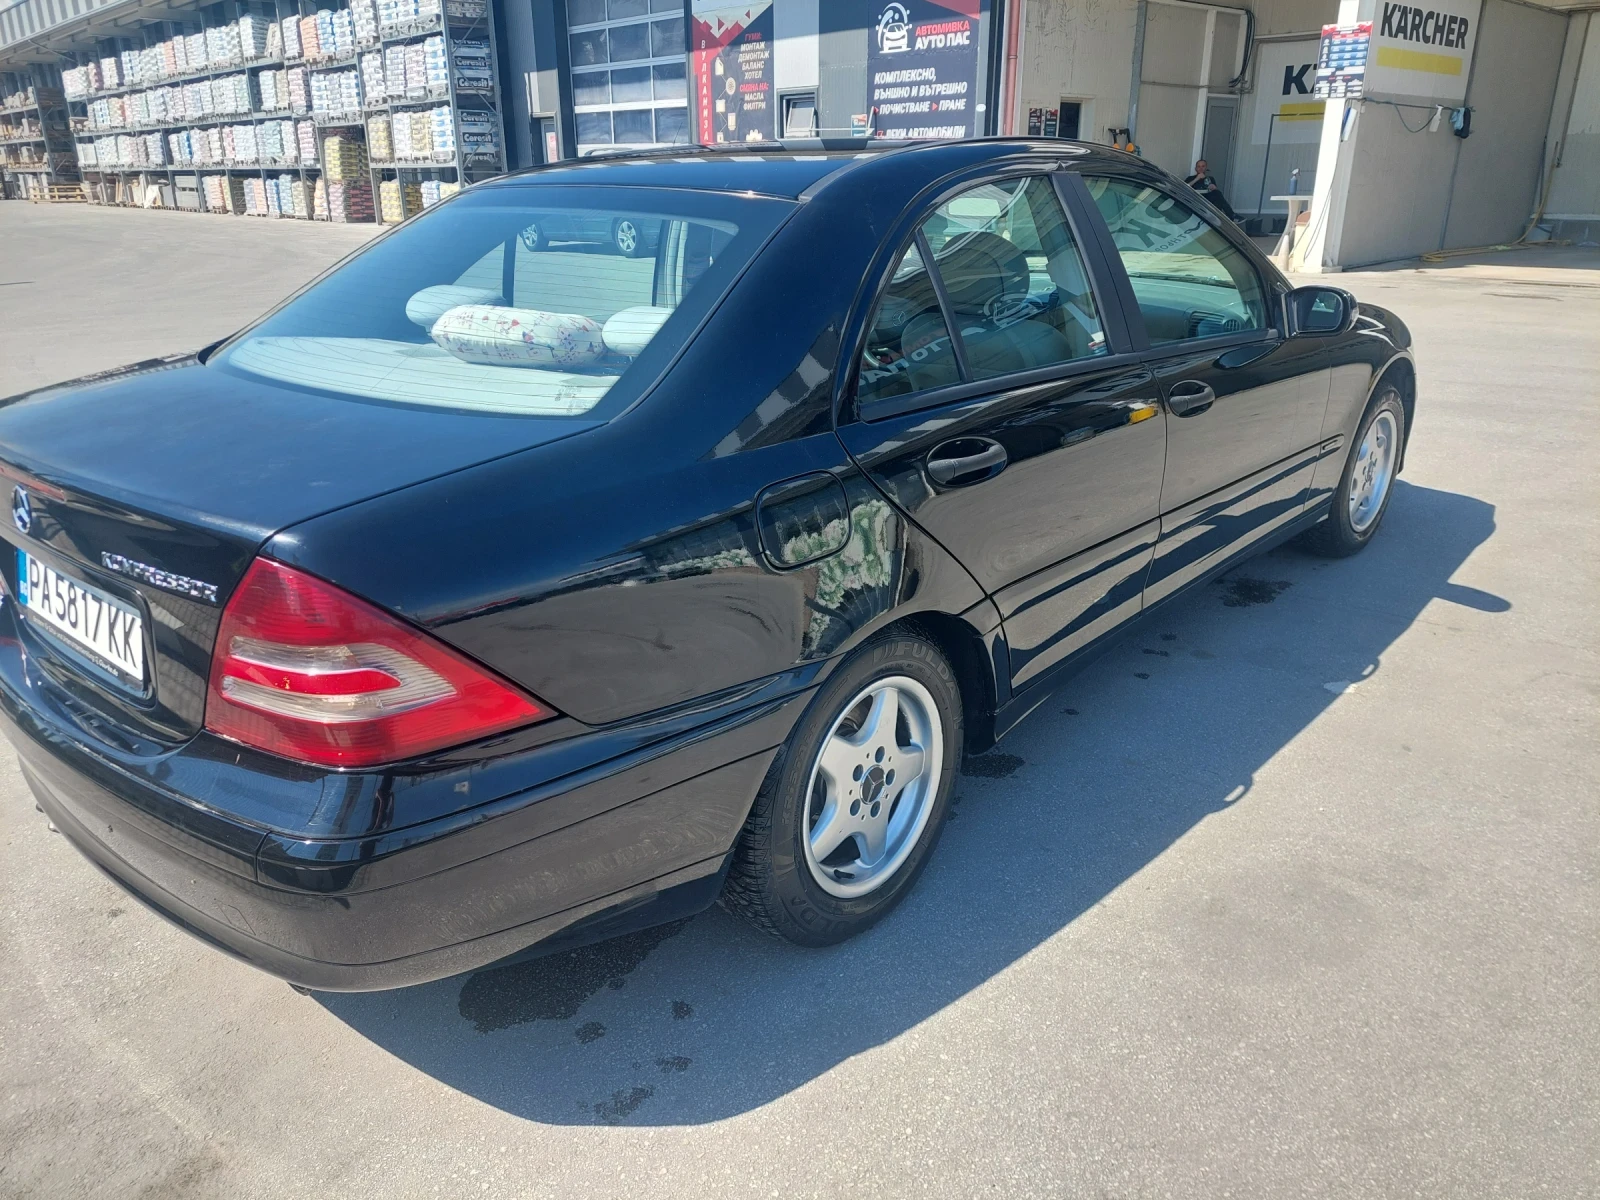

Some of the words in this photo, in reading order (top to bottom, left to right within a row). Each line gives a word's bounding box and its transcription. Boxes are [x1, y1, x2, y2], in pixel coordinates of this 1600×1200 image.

[916, 20, 970, 36] АВТОМИВКА
[1380, 2, 1469, 50] KÄRCHER
[741, 41, 765, 51] МОНТАЖ
[914, 35, 945, 50] АУТО
[946, 31, 971, 46] ПАС
[456, 57, 486, 66] Ceresit
[738, 51, 770, 63] ДЕМОНТАЖ
[742, 61, 764, 71] БАЛАНС
[744, 70, 763, 79] ХОТЕЛ
[874, 67, 936, 85] КОМПЛЕКСНО,
[459, 78, 488, 87] Ceresit
[740, 83, 758, 92] СМЯНА
[874, 87, 910, 100] ВЪНШНО
[911, 86, 918, 97] И
[919, 81, 967, 97] ВЪТРЕШНО
[745, 92, 764, 101] МАСЛА
[743, 102, 766, 111] ФИЛТРИ
[880, 101, 930, 115] ПОЧИСТВАНЕ
[939, 99, 967, 111] ПРАНЕ
[462, 112, 488, 121] Ceresit
[464, 133, 492, 142] Ceresit
[908, 126, 966, 138] АВТОМОБИЛИ
[101, 551, 218, 602] KOMPRESSOR
